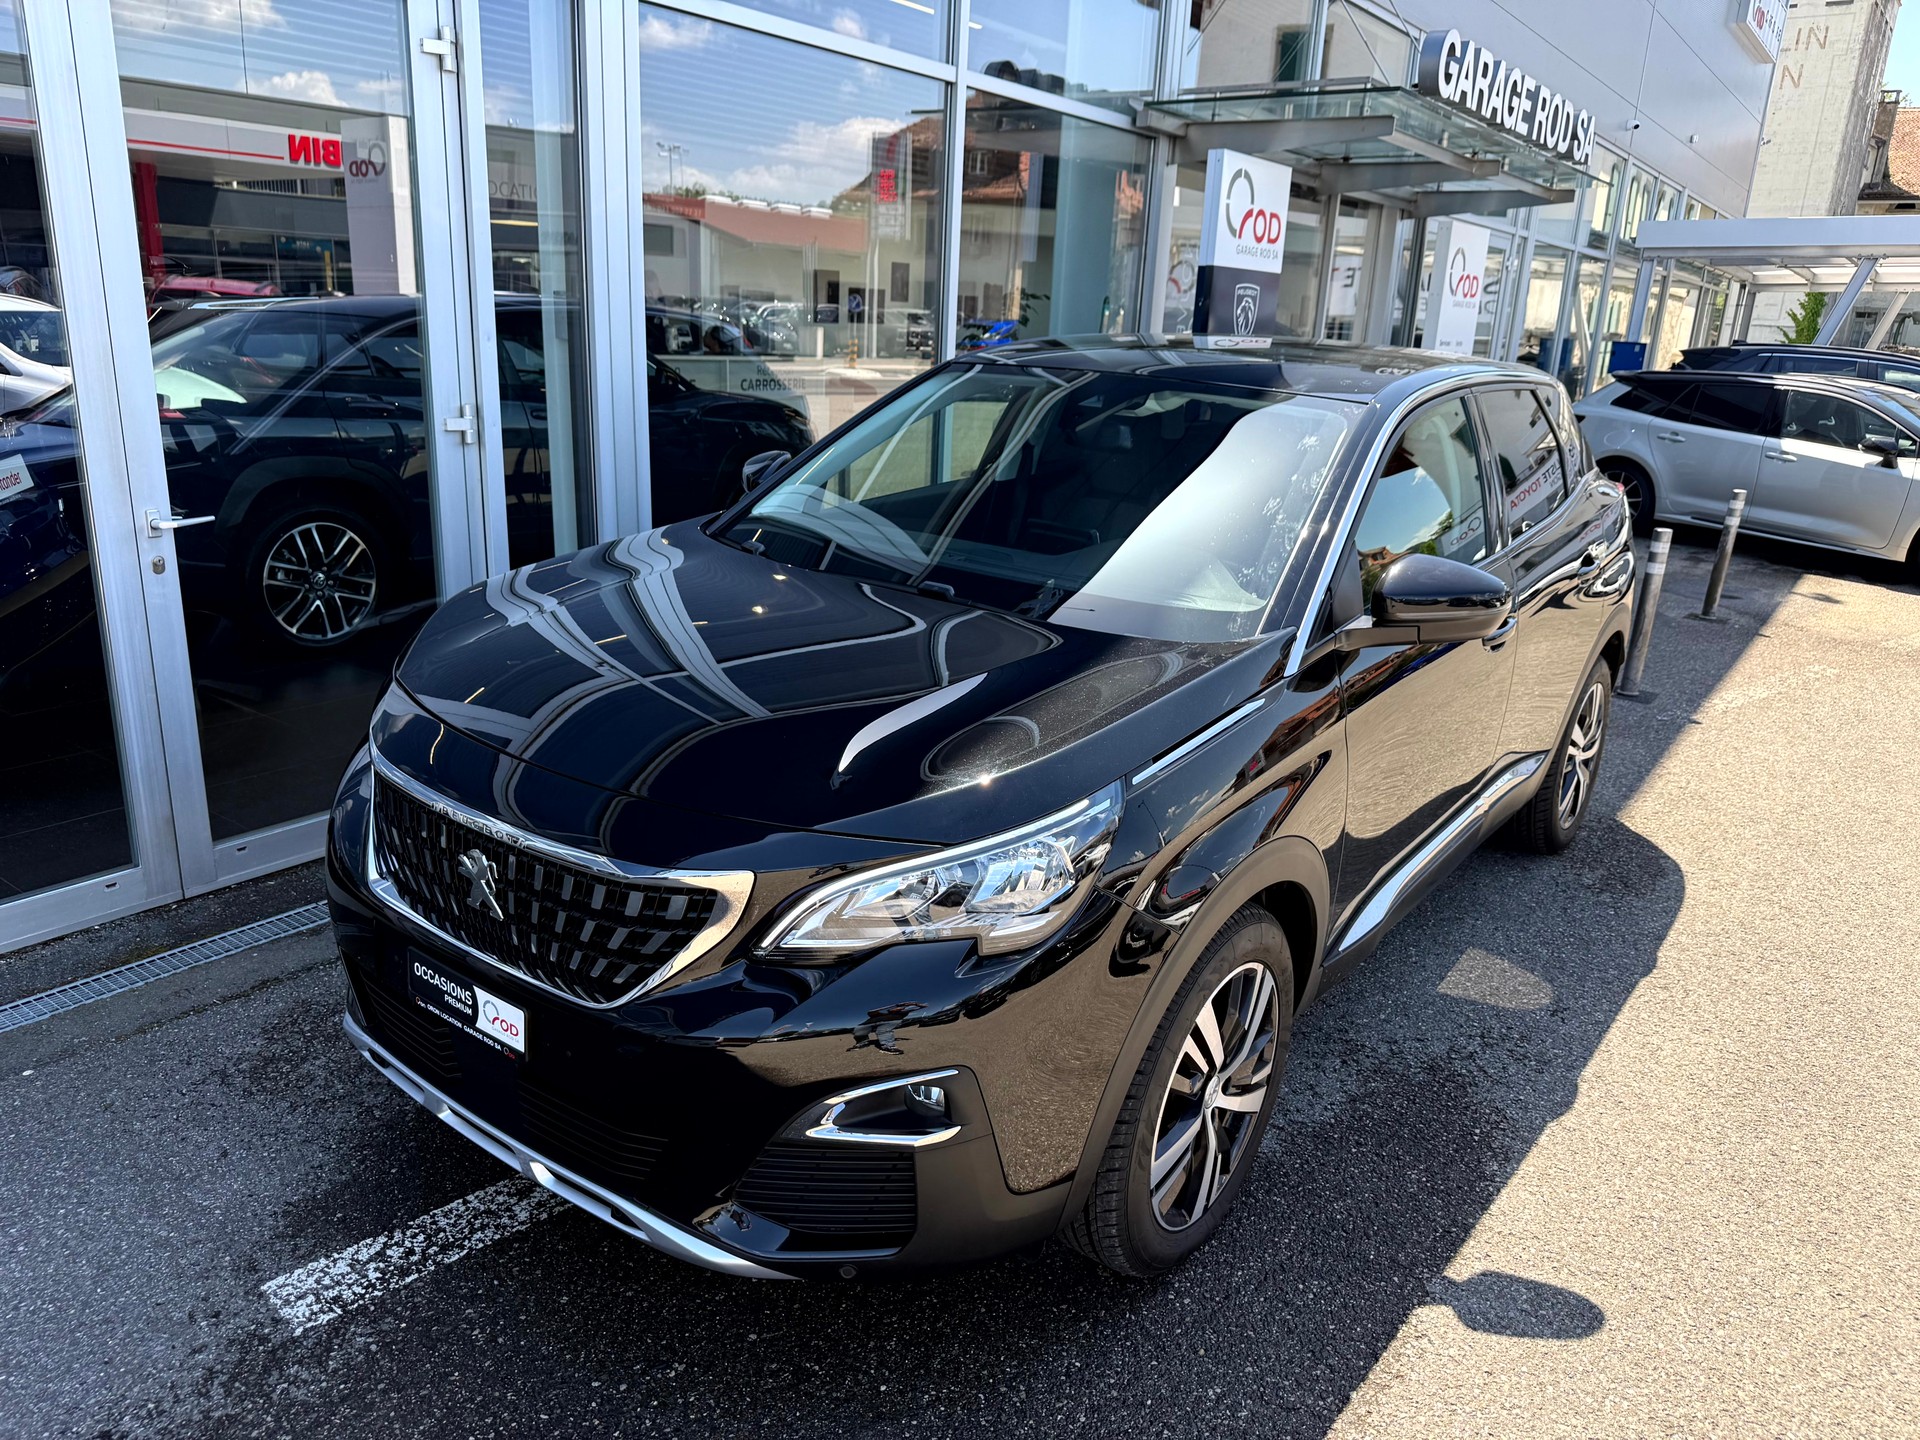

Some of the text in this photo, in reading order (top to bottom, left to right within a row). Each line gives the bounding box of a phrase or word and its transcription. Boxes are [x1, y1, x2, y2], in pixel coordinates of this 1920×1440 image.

[1438, 28, 1596, 165] GARAGE ROD SA
[1236, 243, 1279, 260] GARAGE ROD SA
[1237, 288, 1258, 297] PEUGEOT
[740, 378, 806, 392] CARROSSERIE
[414, 962, 473, 1005] OCCASIONS
[444, 994, 473, 1016] PREMIUM
[440, 1011, 462, 1029] LOCATION
[463, 1025, 484, 1041] GARAGE
[483, 1036, 494, 1047] ROD
[494, 1042, 502, 1051] SA
